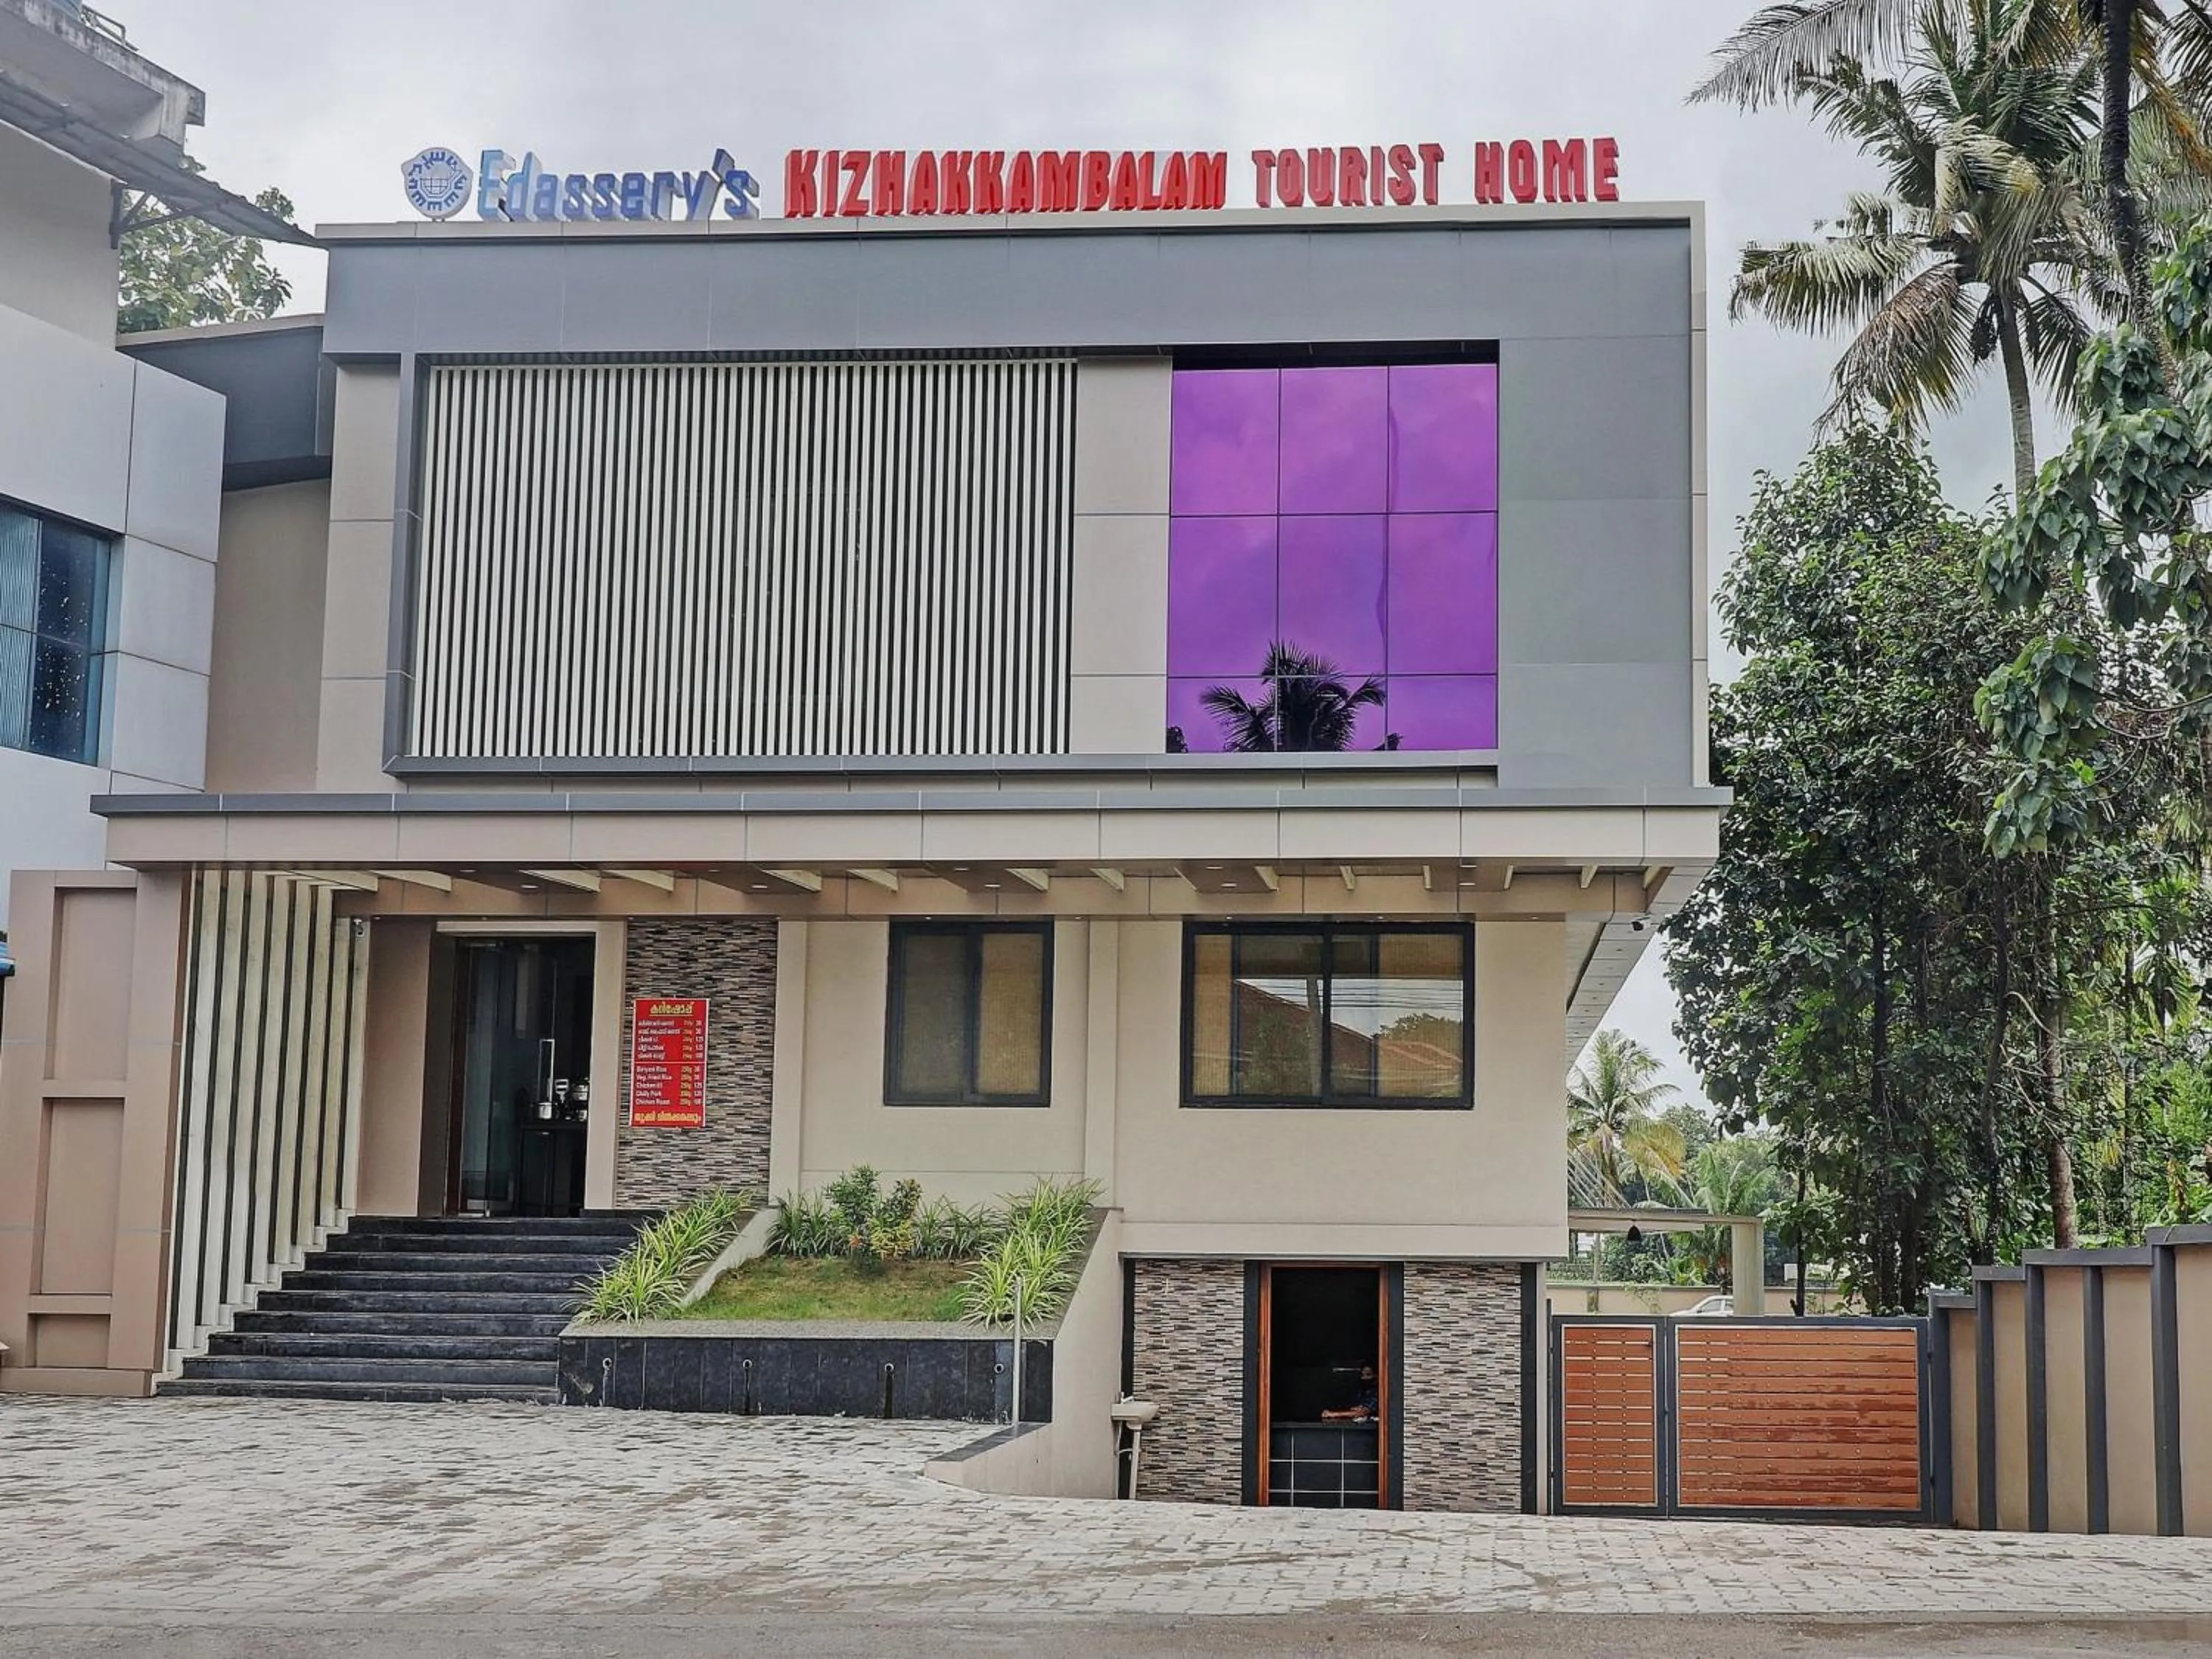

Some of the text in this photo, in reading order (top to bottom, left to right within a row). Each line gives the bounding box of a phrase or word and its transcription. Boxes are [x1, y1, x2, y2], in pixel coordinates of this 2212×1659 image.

[478, 148, 759, 221] Edassery's
[785, 150, 1228, 218] KIZHAKKAMBALAM
[1252, 143, 1444, 208] TOURIST
[1475, 136, 1620, 204] HOME
